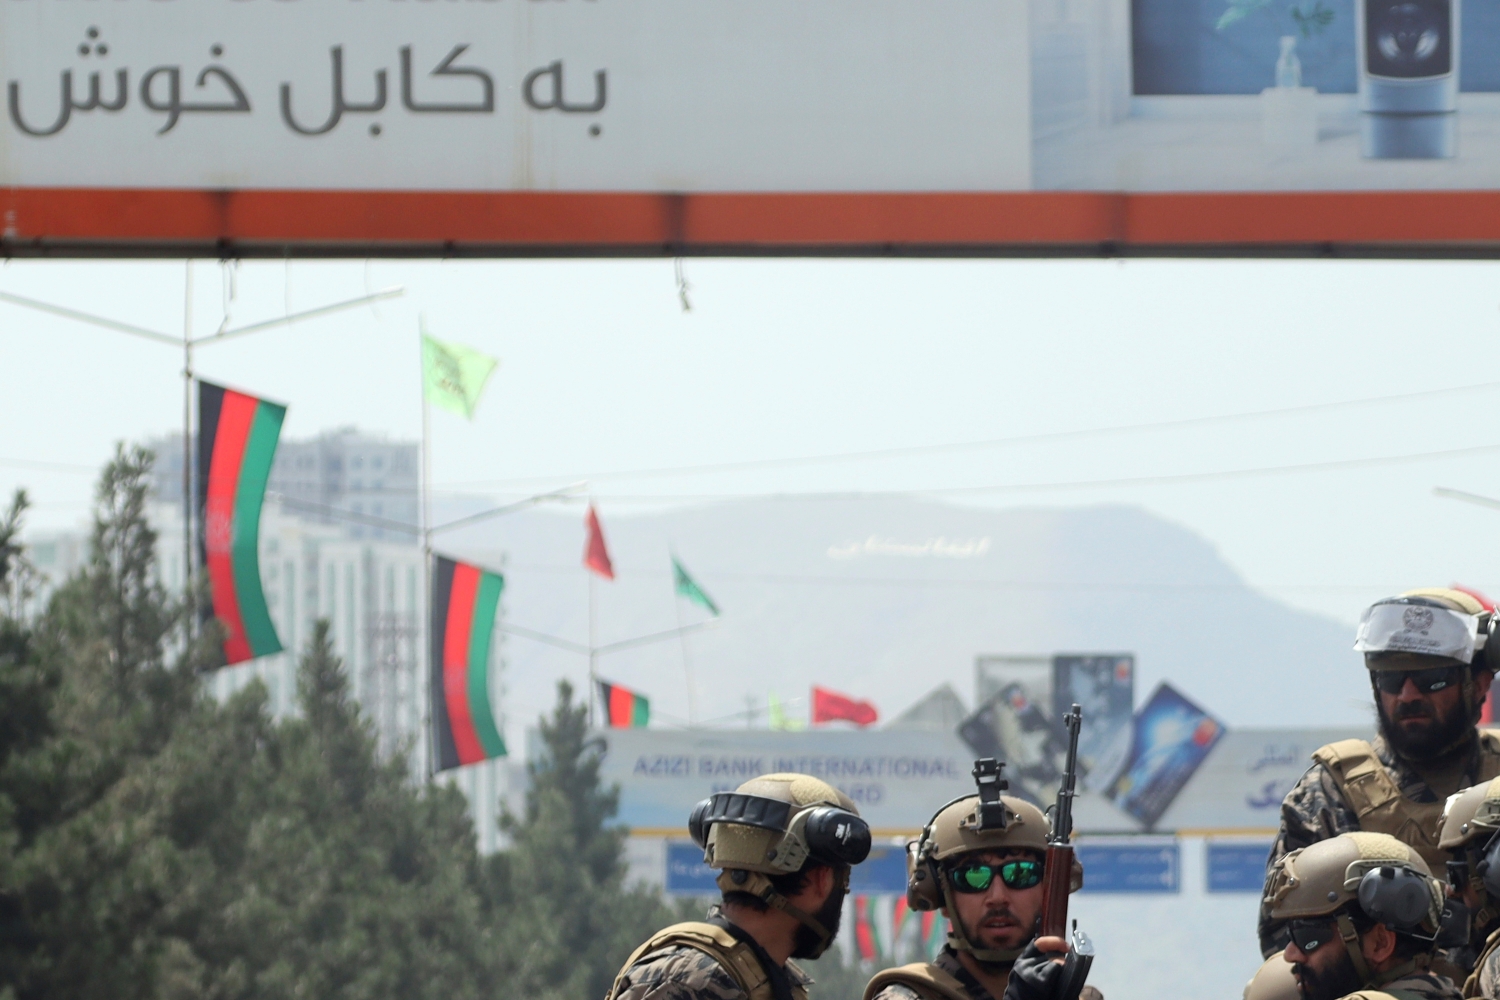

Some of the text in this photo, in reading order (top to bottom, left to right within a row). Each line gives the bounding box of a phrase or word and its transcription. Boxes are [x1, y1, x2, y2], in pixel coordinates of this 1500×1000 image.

[7, 26, 609, 137] به کابل خوش
[633, 756, 959, 779] AZIZI BANK INTERNATIONAL
